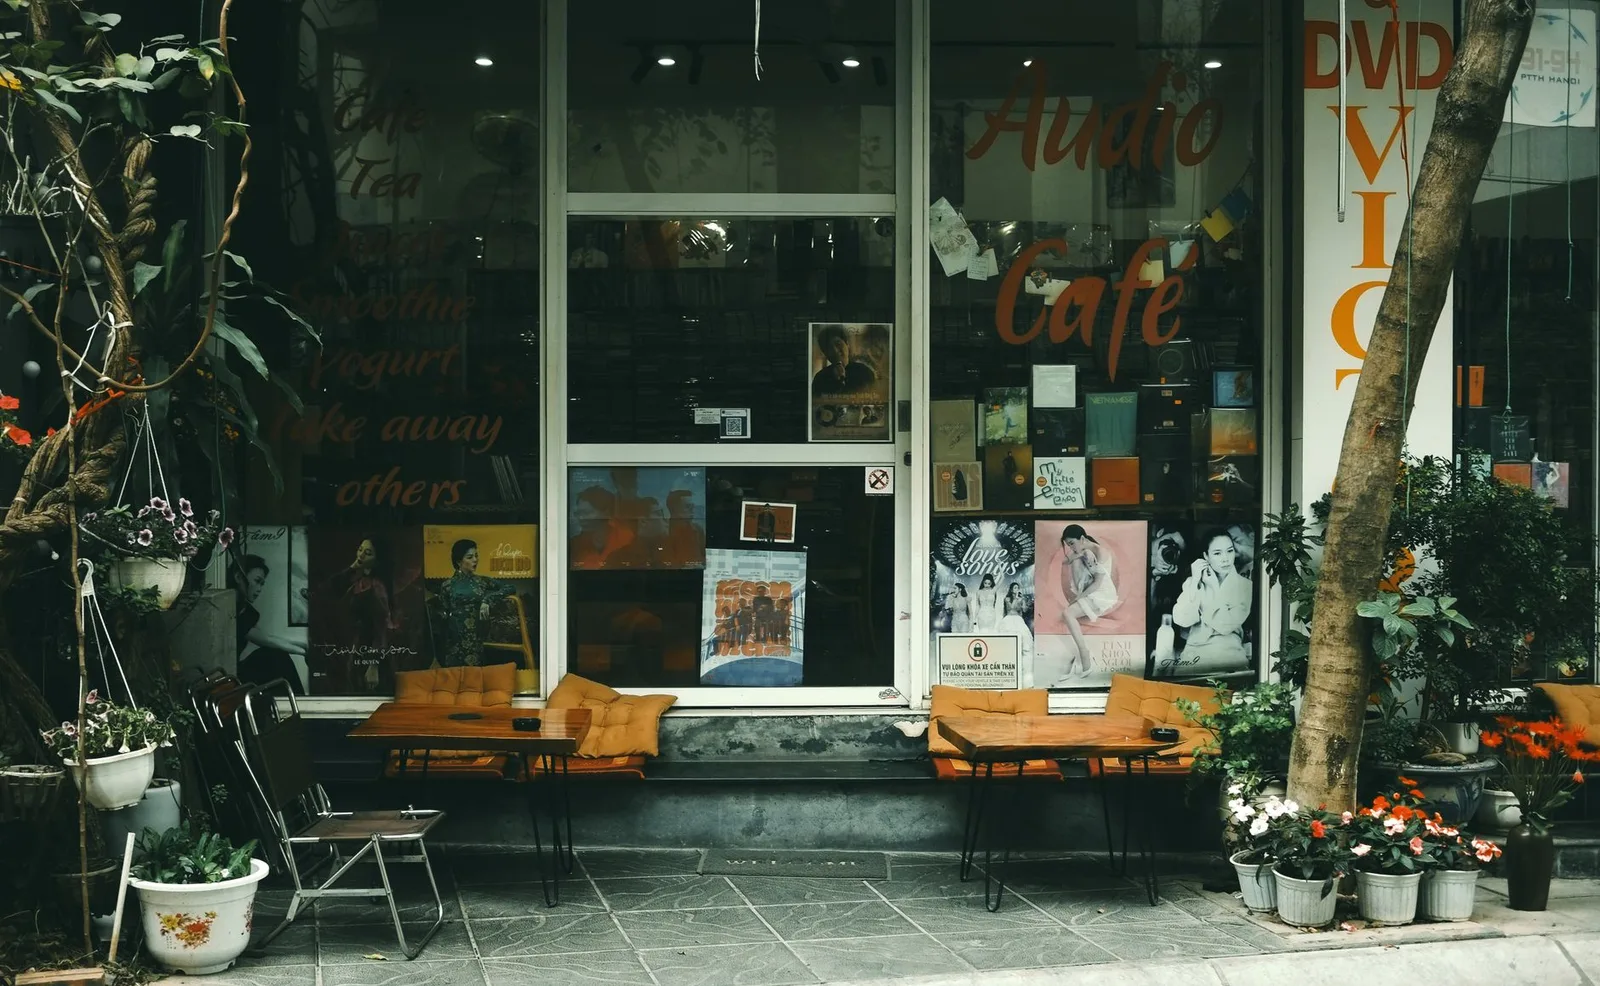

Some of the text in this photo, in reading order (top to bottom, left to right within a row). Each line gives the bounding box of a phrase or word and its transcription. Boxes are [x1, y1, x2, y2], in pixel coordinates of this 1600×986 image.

[1304, 20, 1454, 90] DVD
[1521, 73, 1545, 82] PTTH
[965, 59, 1224, 172] Audio
[350, 156, 423, 200] Tea
[995, 237, 1199, 384] Café
[381, 413, 503, 454] away
[336, 465, 467, 509] others
